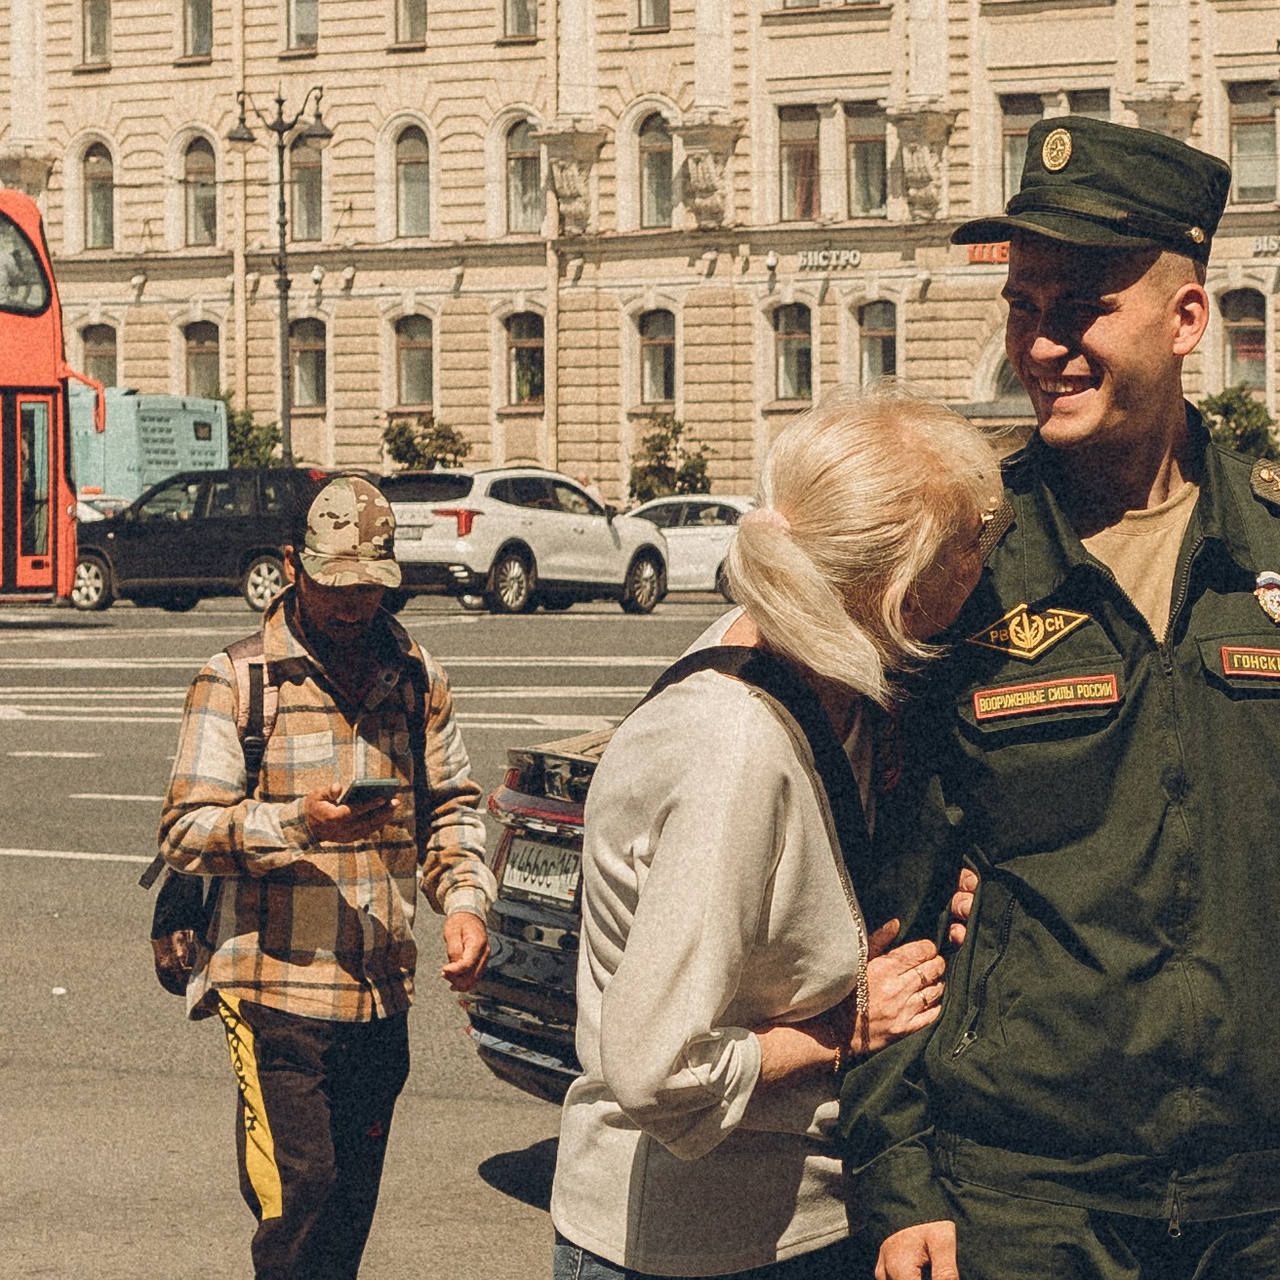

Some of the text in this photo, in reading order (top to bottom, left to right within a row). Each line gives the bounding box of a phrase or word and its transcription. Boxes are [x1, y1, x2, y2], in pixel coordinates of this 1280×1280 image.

[798, 249, 861, 268] БИСТРО
[989, 615, 1065, 643] РВ СН
[979, 682, 1113, 712] ВООРУЖЕННЫЕ СИЛЫ РОССИИ
